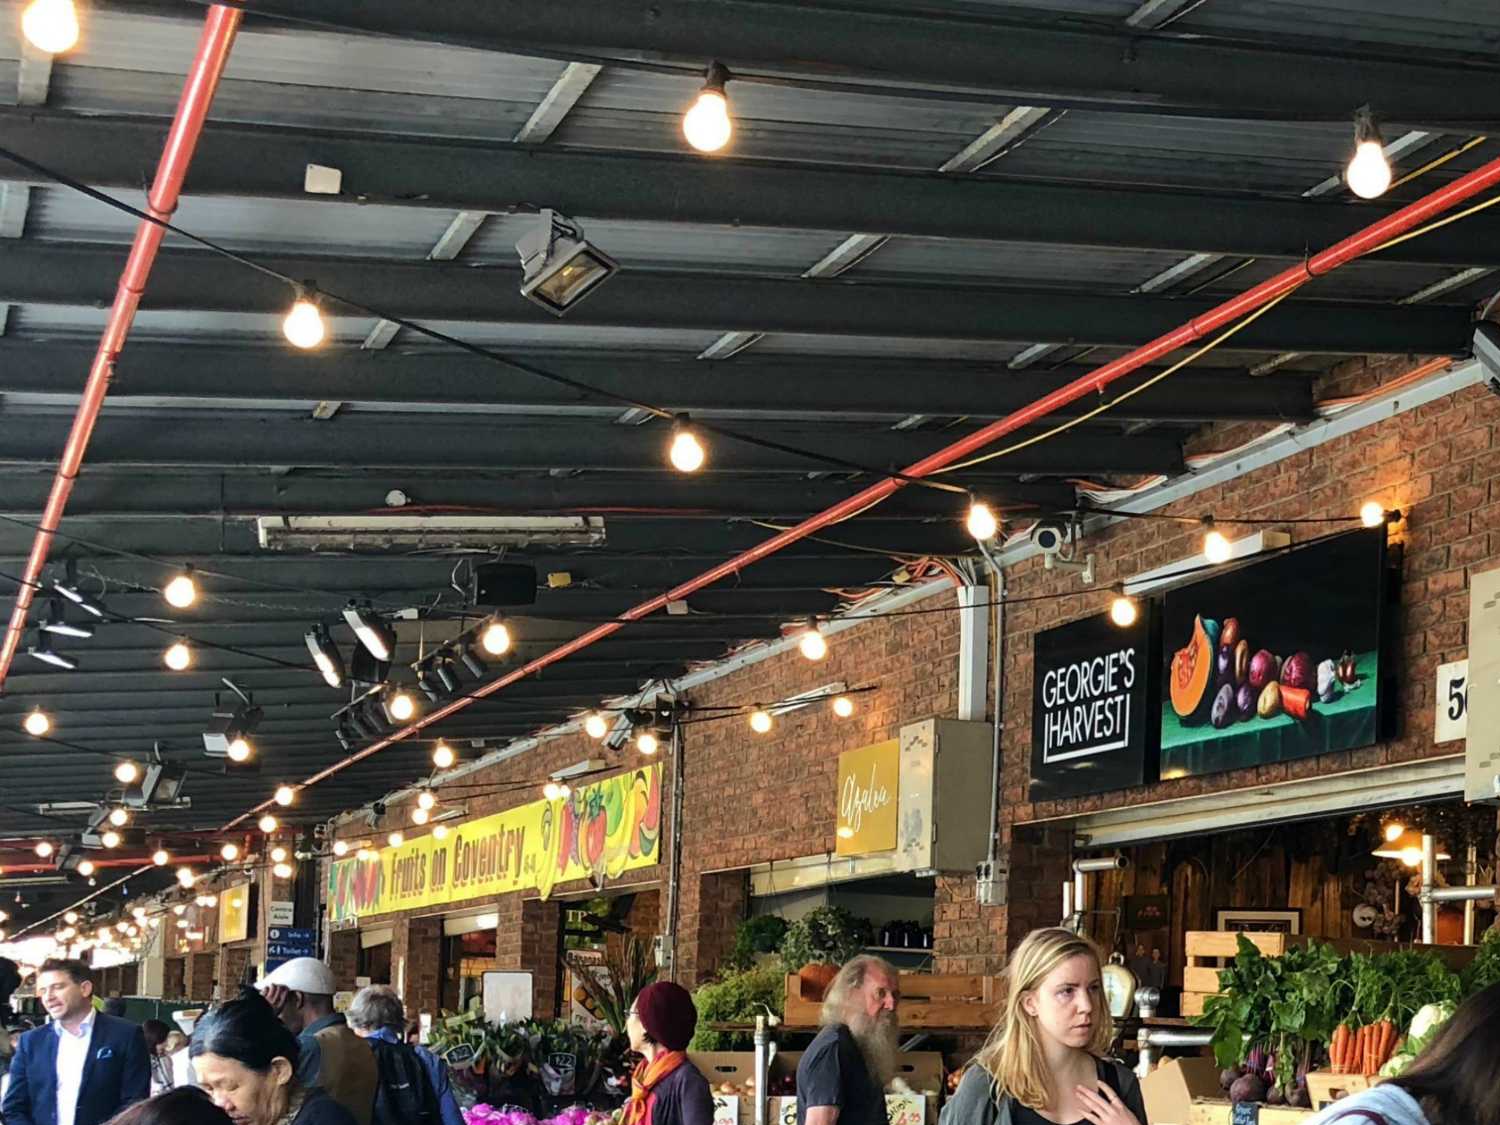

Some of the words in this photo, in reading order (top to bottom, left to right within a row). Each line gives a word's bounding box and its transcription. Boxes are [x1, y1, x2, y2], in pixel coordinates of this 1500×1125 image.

[1043, 648, 1135, 708] GEORGIE'S
[1448, 677, 1468, 721] 5
[1049, 695, 1124, 748] HARVEST
[431, 847, 447, 888] on
[454, 824, 526, 885] Coventry
